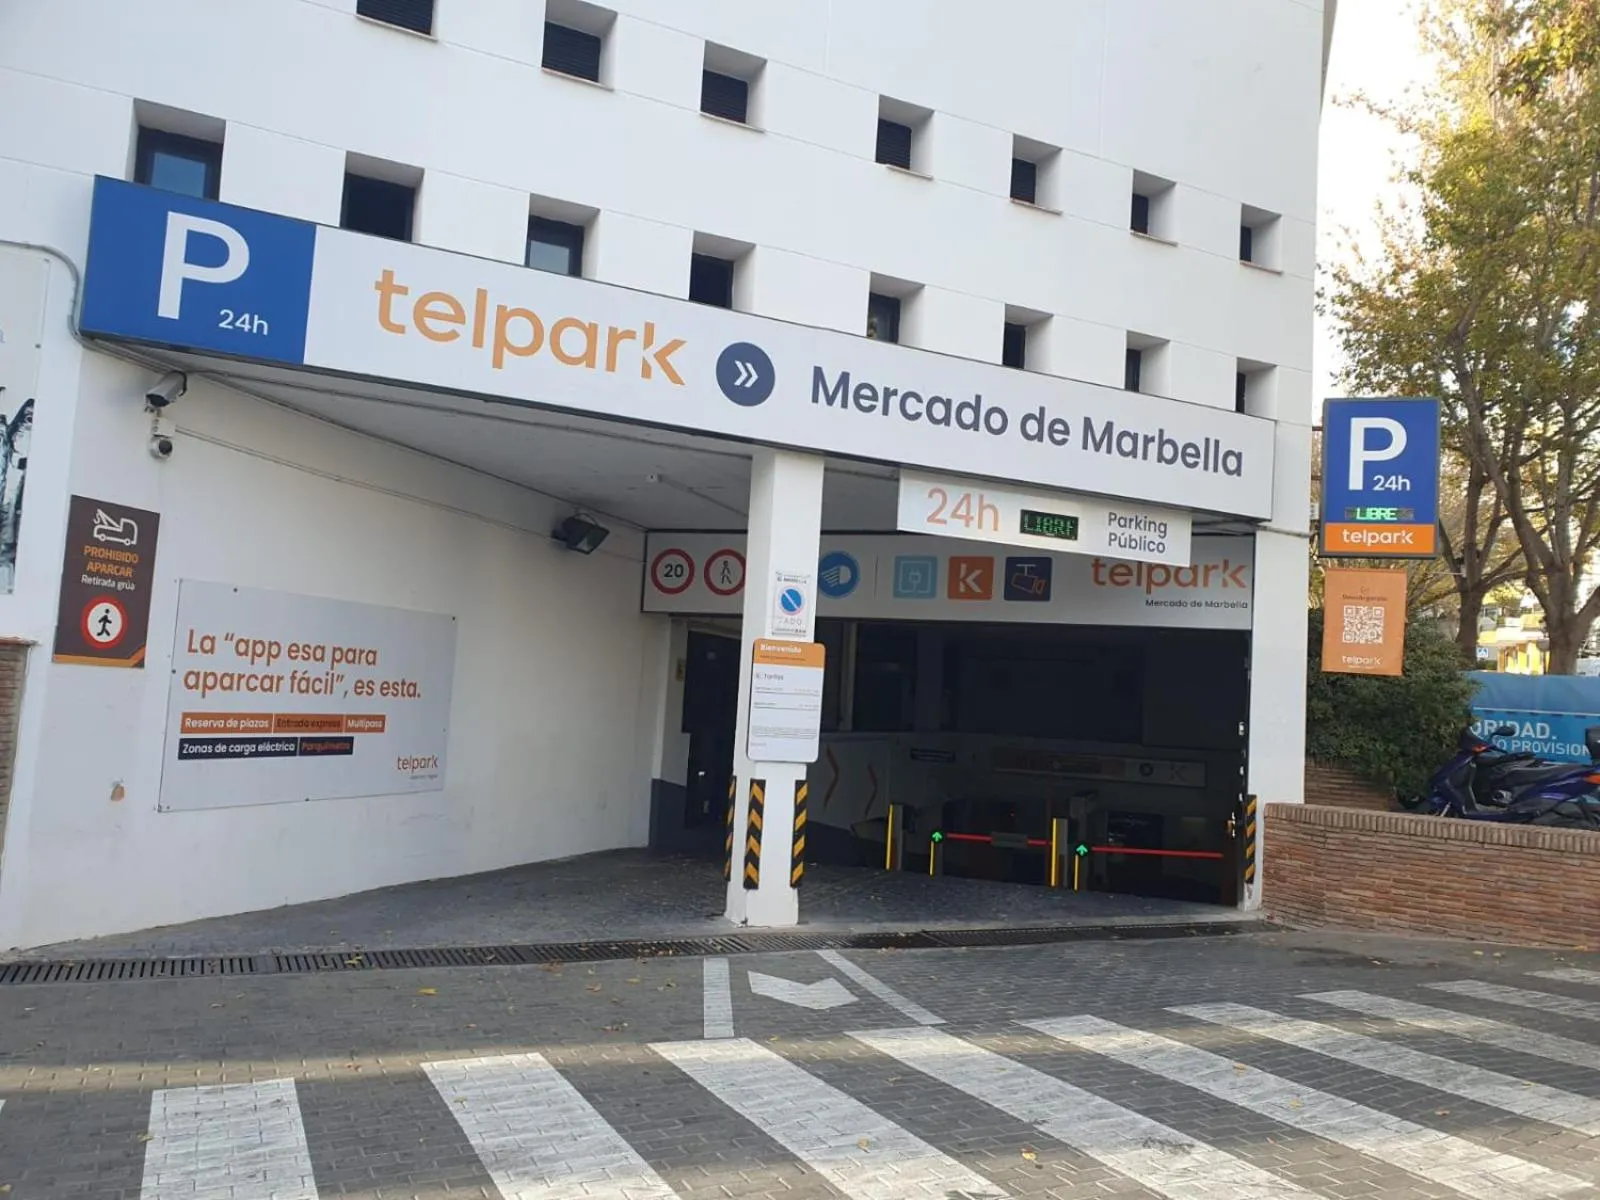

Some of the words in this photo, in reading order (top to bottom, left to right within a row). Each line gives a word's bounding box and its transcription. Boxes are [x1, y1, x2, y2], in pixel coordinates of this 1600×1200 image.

[157, 210, 250, 321] P
[218, 308, 270, 337] 24h
[374, 268, 686, 387] telpark
[811, 365, 1009, 436] Mercado
[1020, 406, 1070, 446] de
[1082, 416, 1243, 477] Marbella
[1348, 416, 1407, 491] P
[1372, 474, 1411, 491] 24h
[926, 486, 999, 532] 24h
[1356, 507, 1398, 521] LIBRE
[1108, 511, 1168, 538] Parking
[1108, 532, 1166, 554] Público
[1342, 528, 1413, 547] telpark
[83, 545, 139, 564] PROHIBIDO
[86, 561, 133, 577] APARCAR
[664, 563, 684, 578] 20
[1091, 557, 1248, 595] telpark
[81, 574, 116, 588] Retirada
[117, 579, 136, 592] grúa
[1145, 599, 1188, 608] Mercado
[1190, 599, 1203, 608] de
[1205, 600, 1248, 609] Marbella
[187, 629, 216, 655] La
[288, 641, 326, 663] esa
[331, 645, 378, 670] para
[183, 668, 284, 699] aparcar
[354, 679, 375, 697] es
[380, 678, 421, 698] esta.
[185, 718, 225, 728] Reserva
[226, 718, 239, 728] de
[240, 719, 269, 730] plazas
[347, 719, 383, 731] Multipass
[182, 743, 213, 754] Zonas
[214, 742, 227, 752] de
[228, 744, 256, 755] carga
[257, 741, 295, 752] eléctrica
[397, 755, 438, 773] telpark
